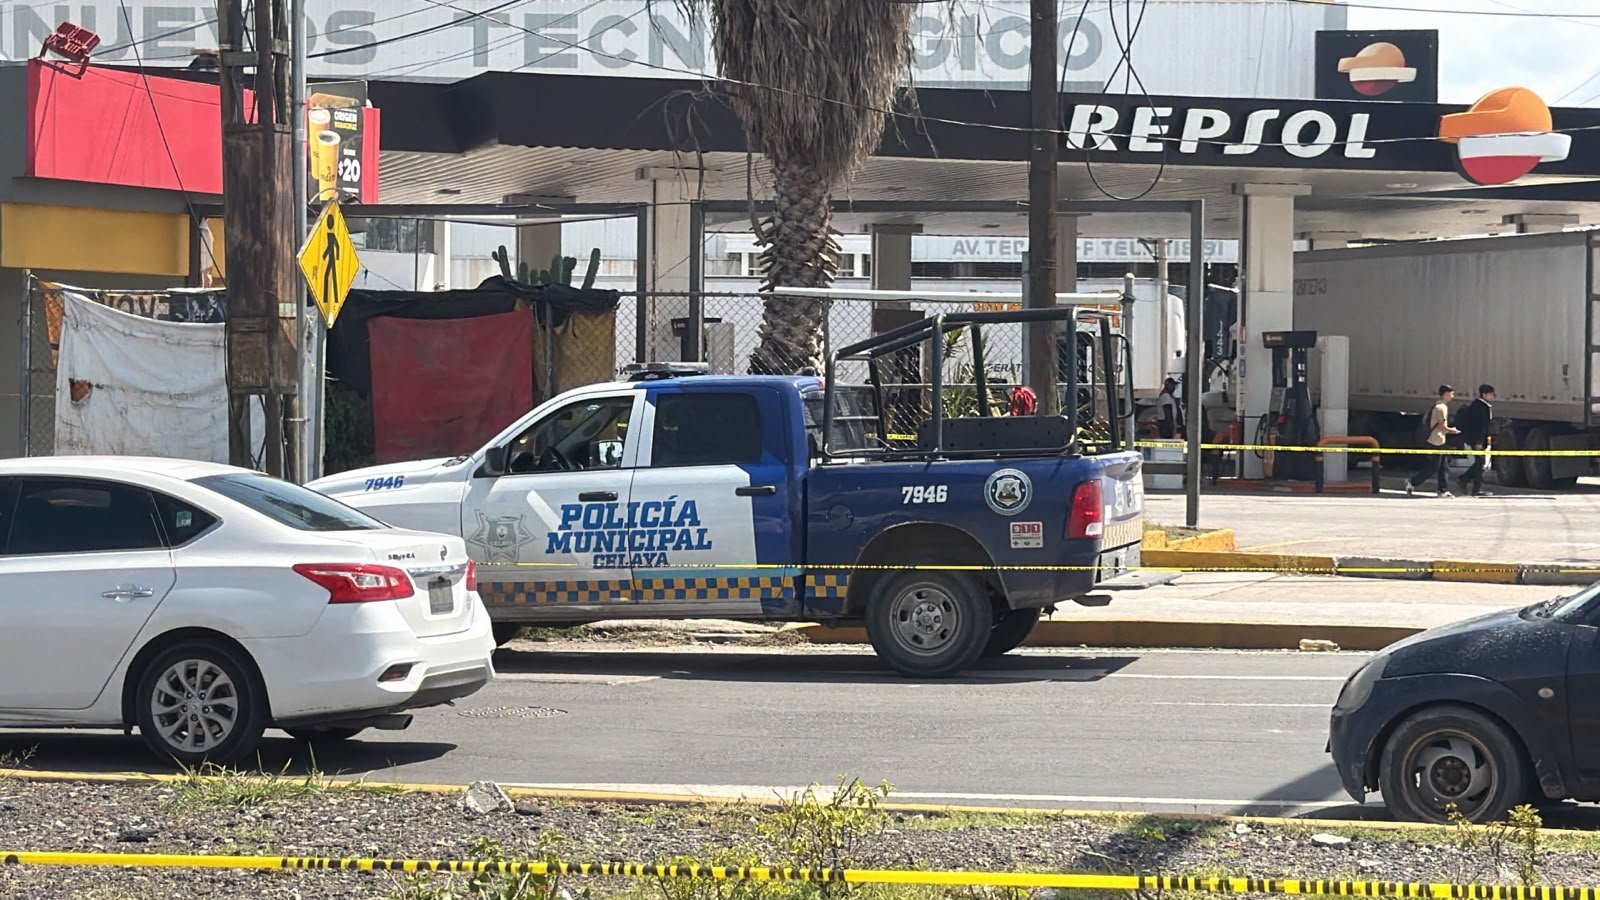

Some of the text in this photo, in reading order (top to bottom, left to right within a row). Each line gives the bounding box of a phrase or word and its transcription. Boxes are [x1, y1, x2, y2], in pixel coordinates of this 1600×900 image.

[1066, 104, 1377, 158] REPSOL
[338, 158, 360, 182] $20
[365, 475, 405, 492] 7946
[902, 486, 948, 504] 7946
[558, 495, 701, 530] POLICÍA
[545, 528, 712, 554] MUNICIPAL
[592, 551, 669, 569] CELAYA
